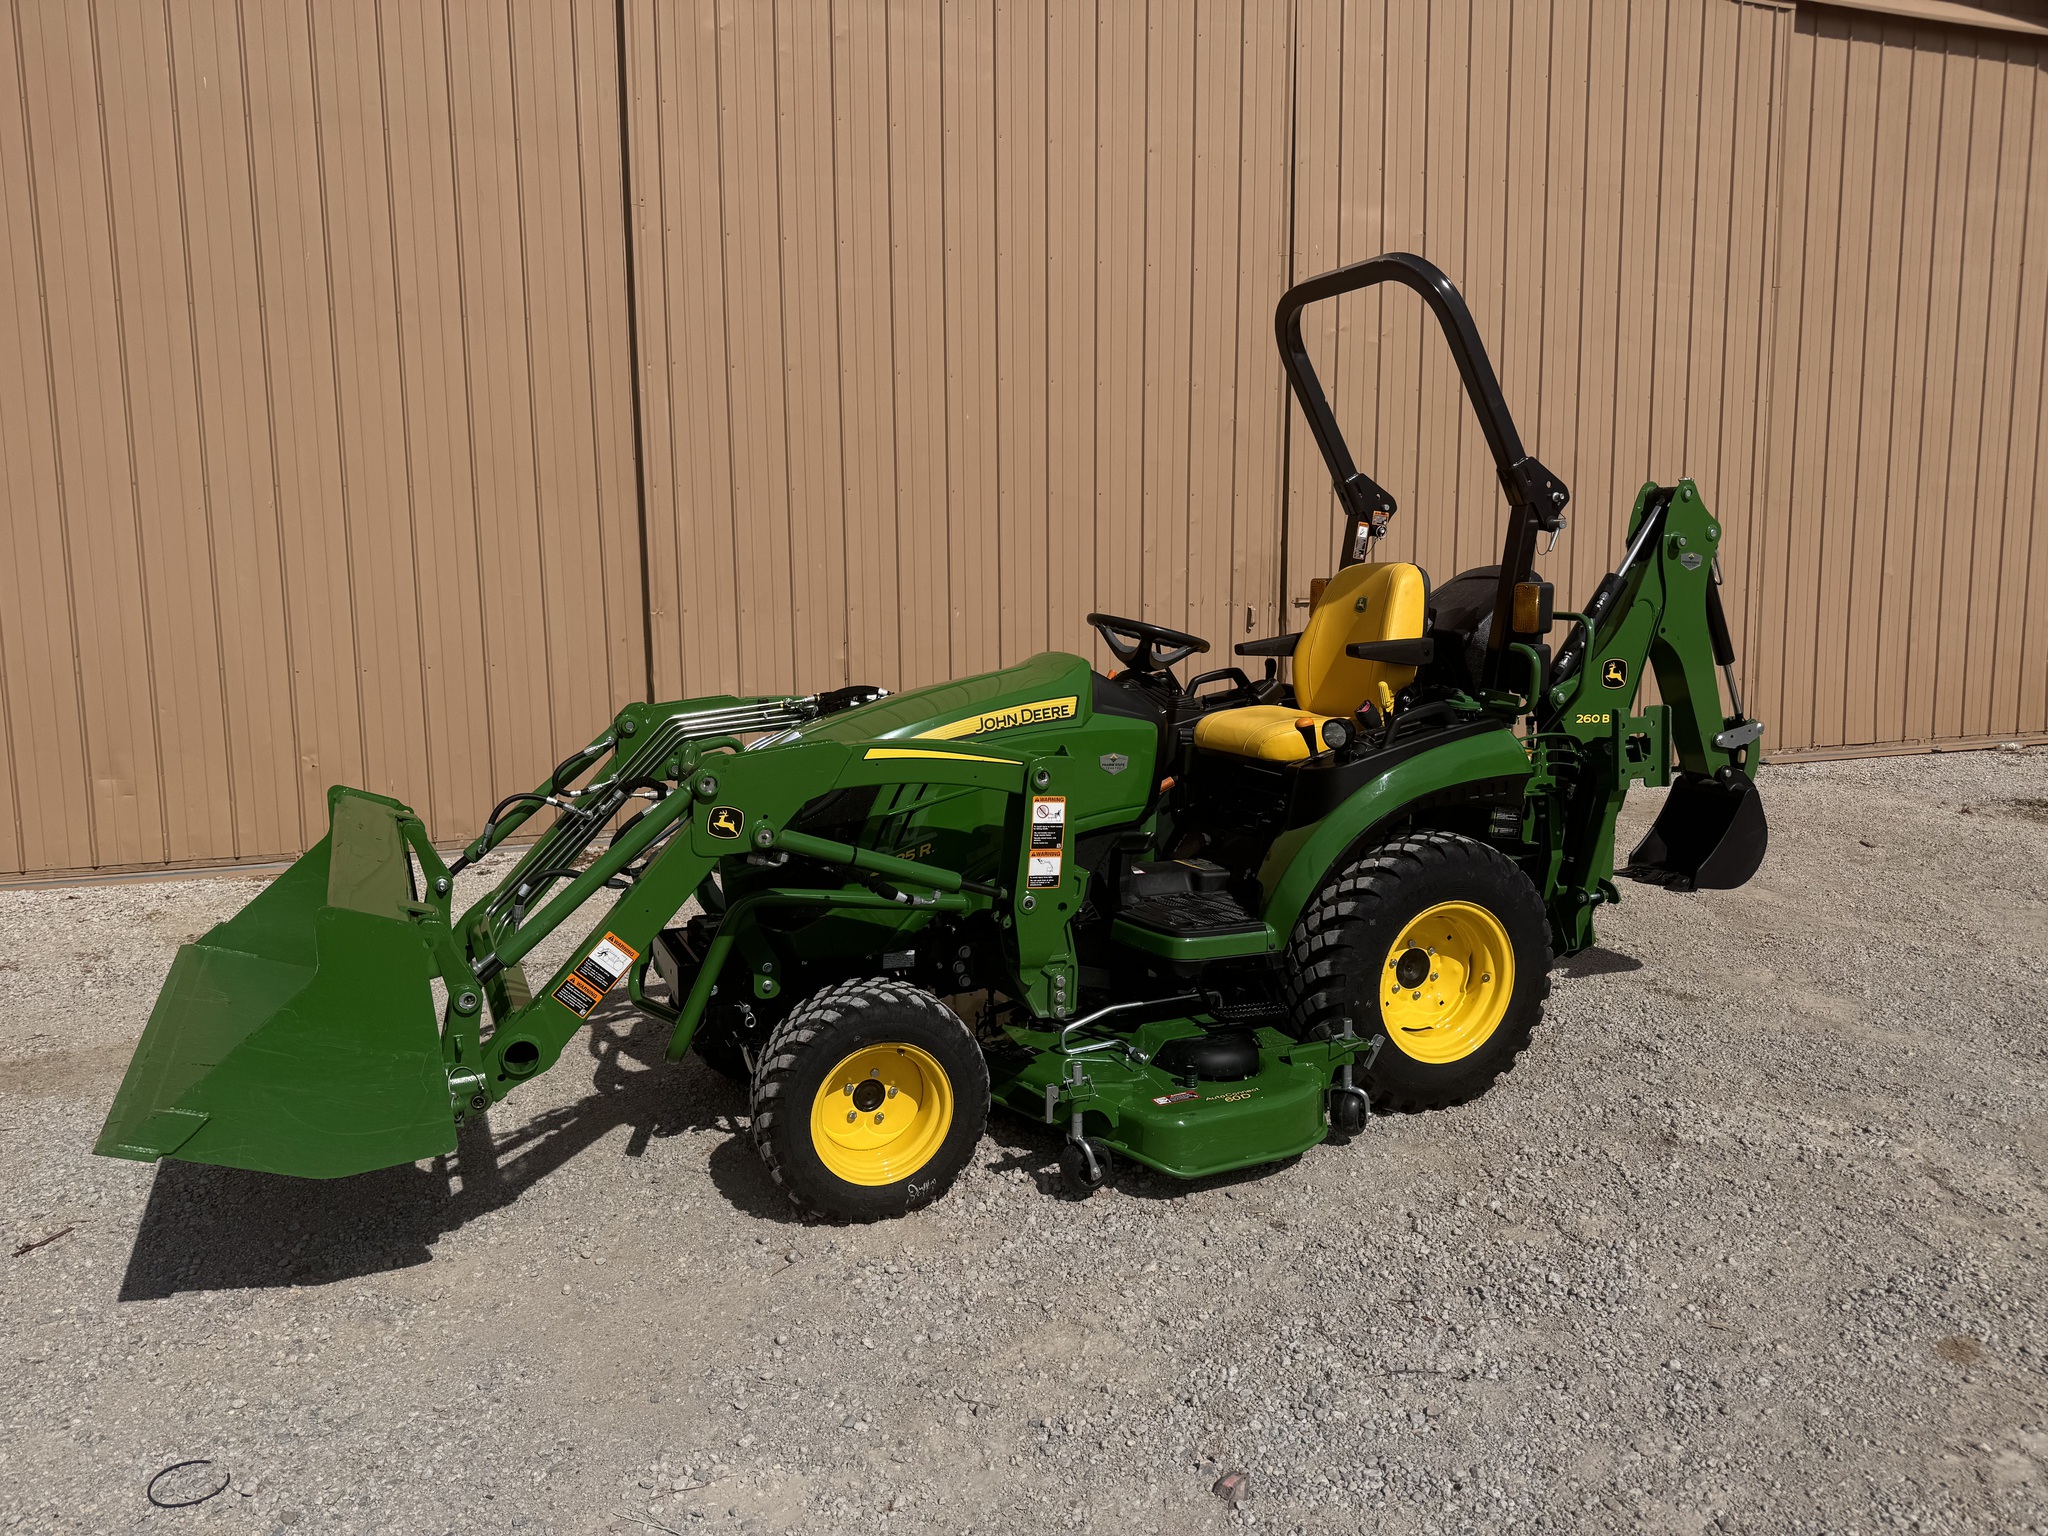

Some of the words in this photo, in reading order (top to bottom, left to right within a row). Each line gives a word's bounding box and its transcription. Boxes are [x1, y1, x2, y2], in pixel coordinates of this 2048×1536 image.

[975, 713, 1018, 733] JOHN
[1020, 704, 1070, 723] DEERE
[1575, 713, 1601, 724] 260
[1602, 713, 1610, 724] B
[919, 843, 932, 858] R
[613, 940, 635, 957] WARNING
[576, 981, 598, 999] WARNING
[1205, 1087, 1260, 1101] AutoConnect
